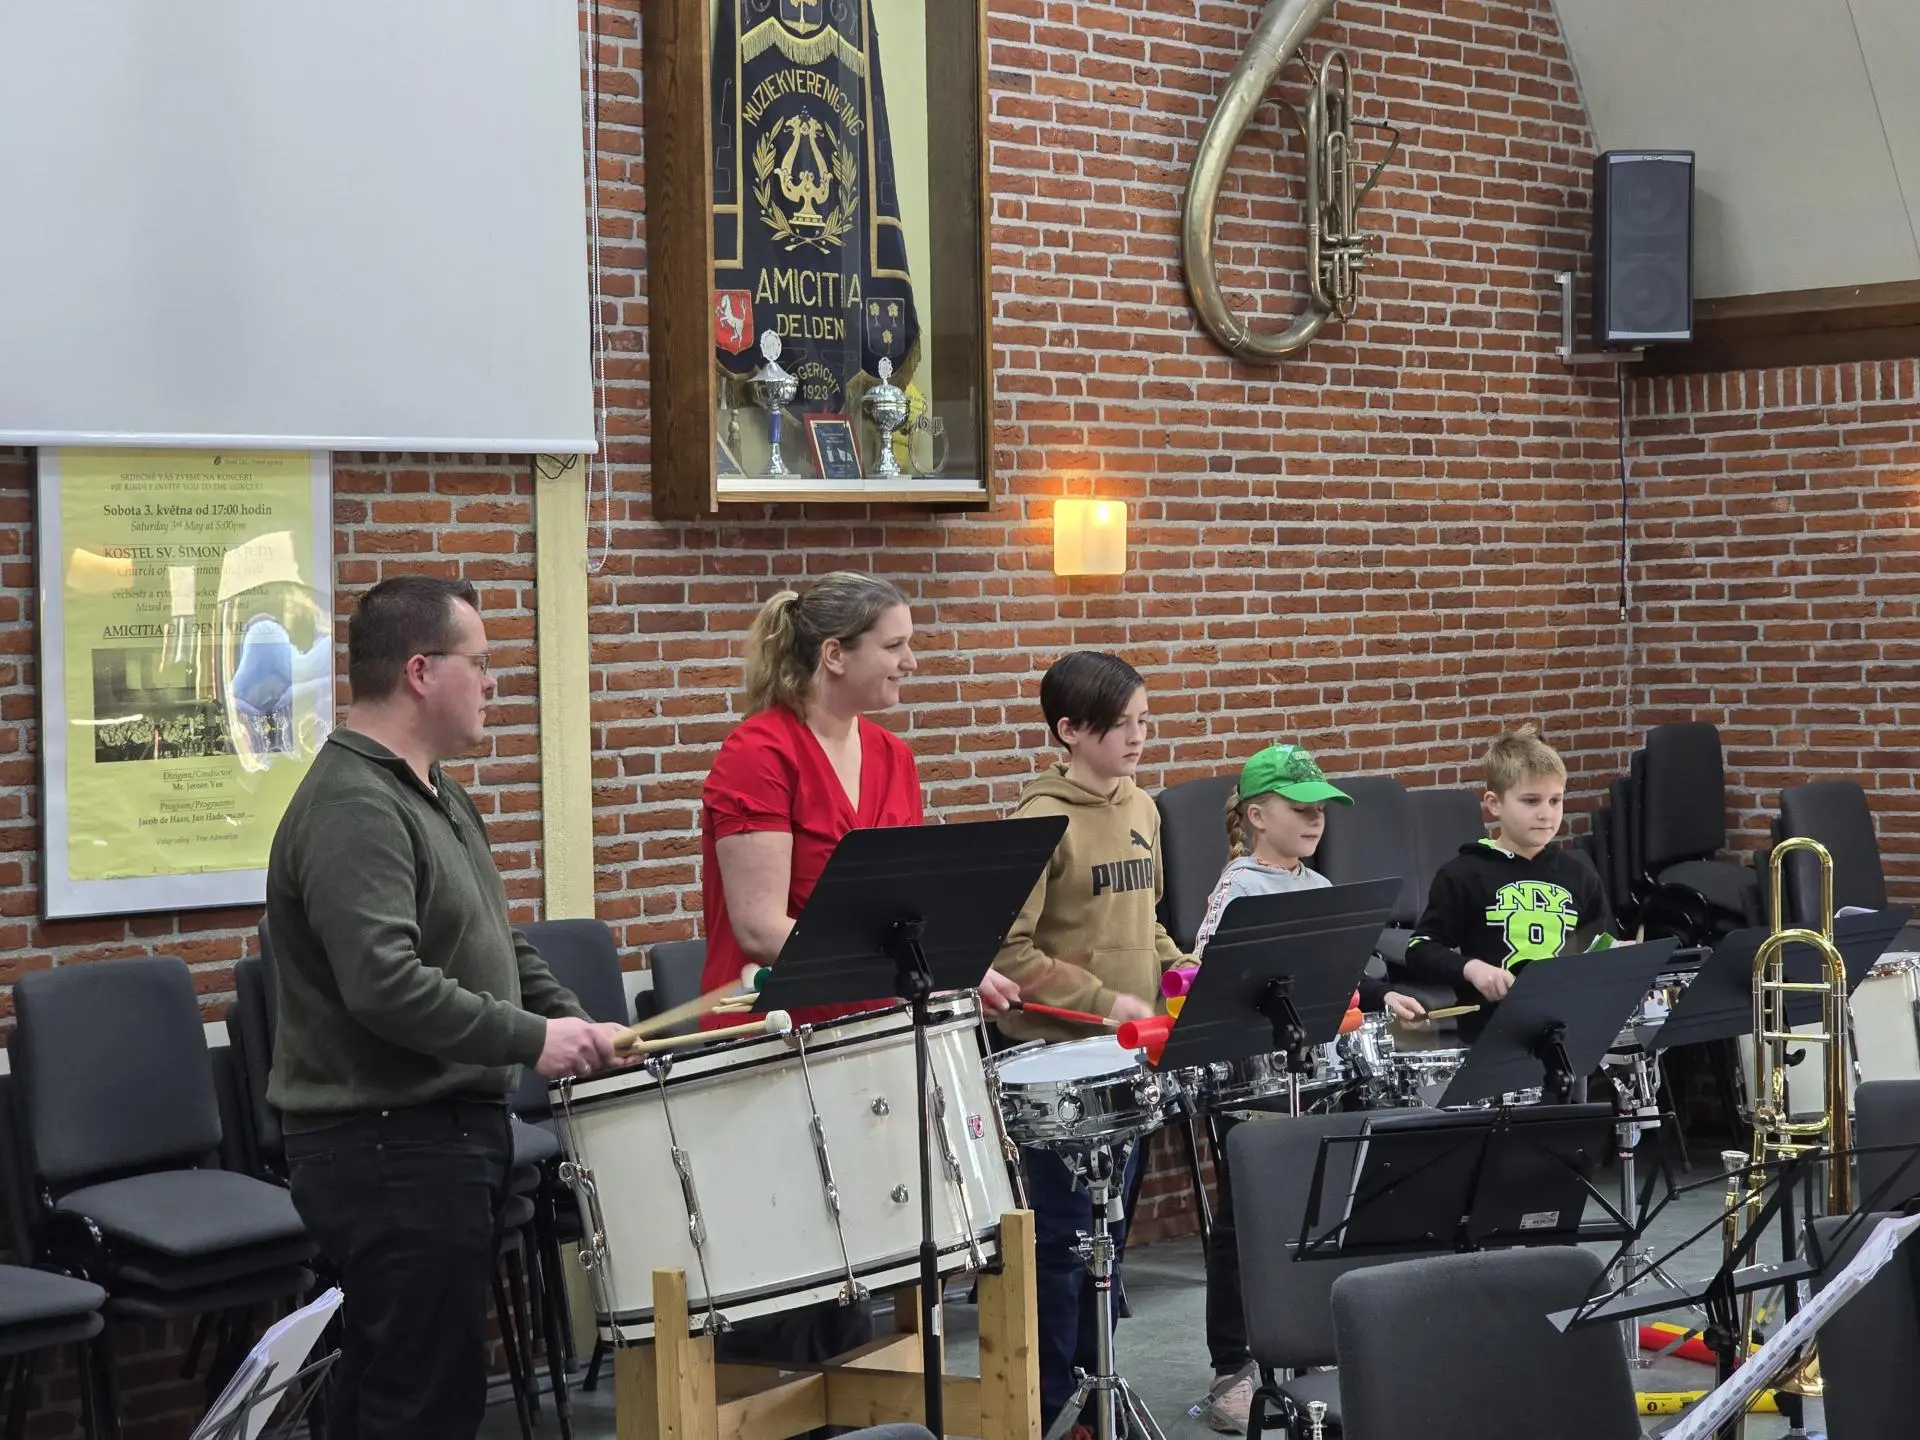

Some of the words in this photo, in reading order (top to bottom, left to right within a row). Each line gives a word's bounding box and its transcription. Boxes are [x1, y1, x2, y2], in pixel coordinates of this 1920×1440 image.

[742, 69, 865, 136] MUZIEKVERENIGING
[755, 267, 863, 310] AMICITIA
[776, 313, 845, 340] DELDEN
[790, 362, 841, 394] GERICHT
[803, 384, 829, 400] 1923
[104, 504, 141, 516] Sobota
[144, 505, 153, 516] 3.
[156, 504, 193, 516] května
[195, 503, 209, 516] od
[213, 504, 239, 515] 17:00
[241, 503, 272, 515] hodin
[131, 521, 169, 533] Saturday
[185, 520, 203, 533] May
[205, 521, 214, 531] at
[104, 547, 153, 559] KOSTEL
[156, 547, 176, 559] SV.
[178, 544, 227, 558] ŠIMONA
[103, 623, 163, 637] AMICITIA
[139, 817, 159, 827] Jacob
[1091, 858, 1153, 897] PUMA
[1496, 880, 1572, 913] NY
